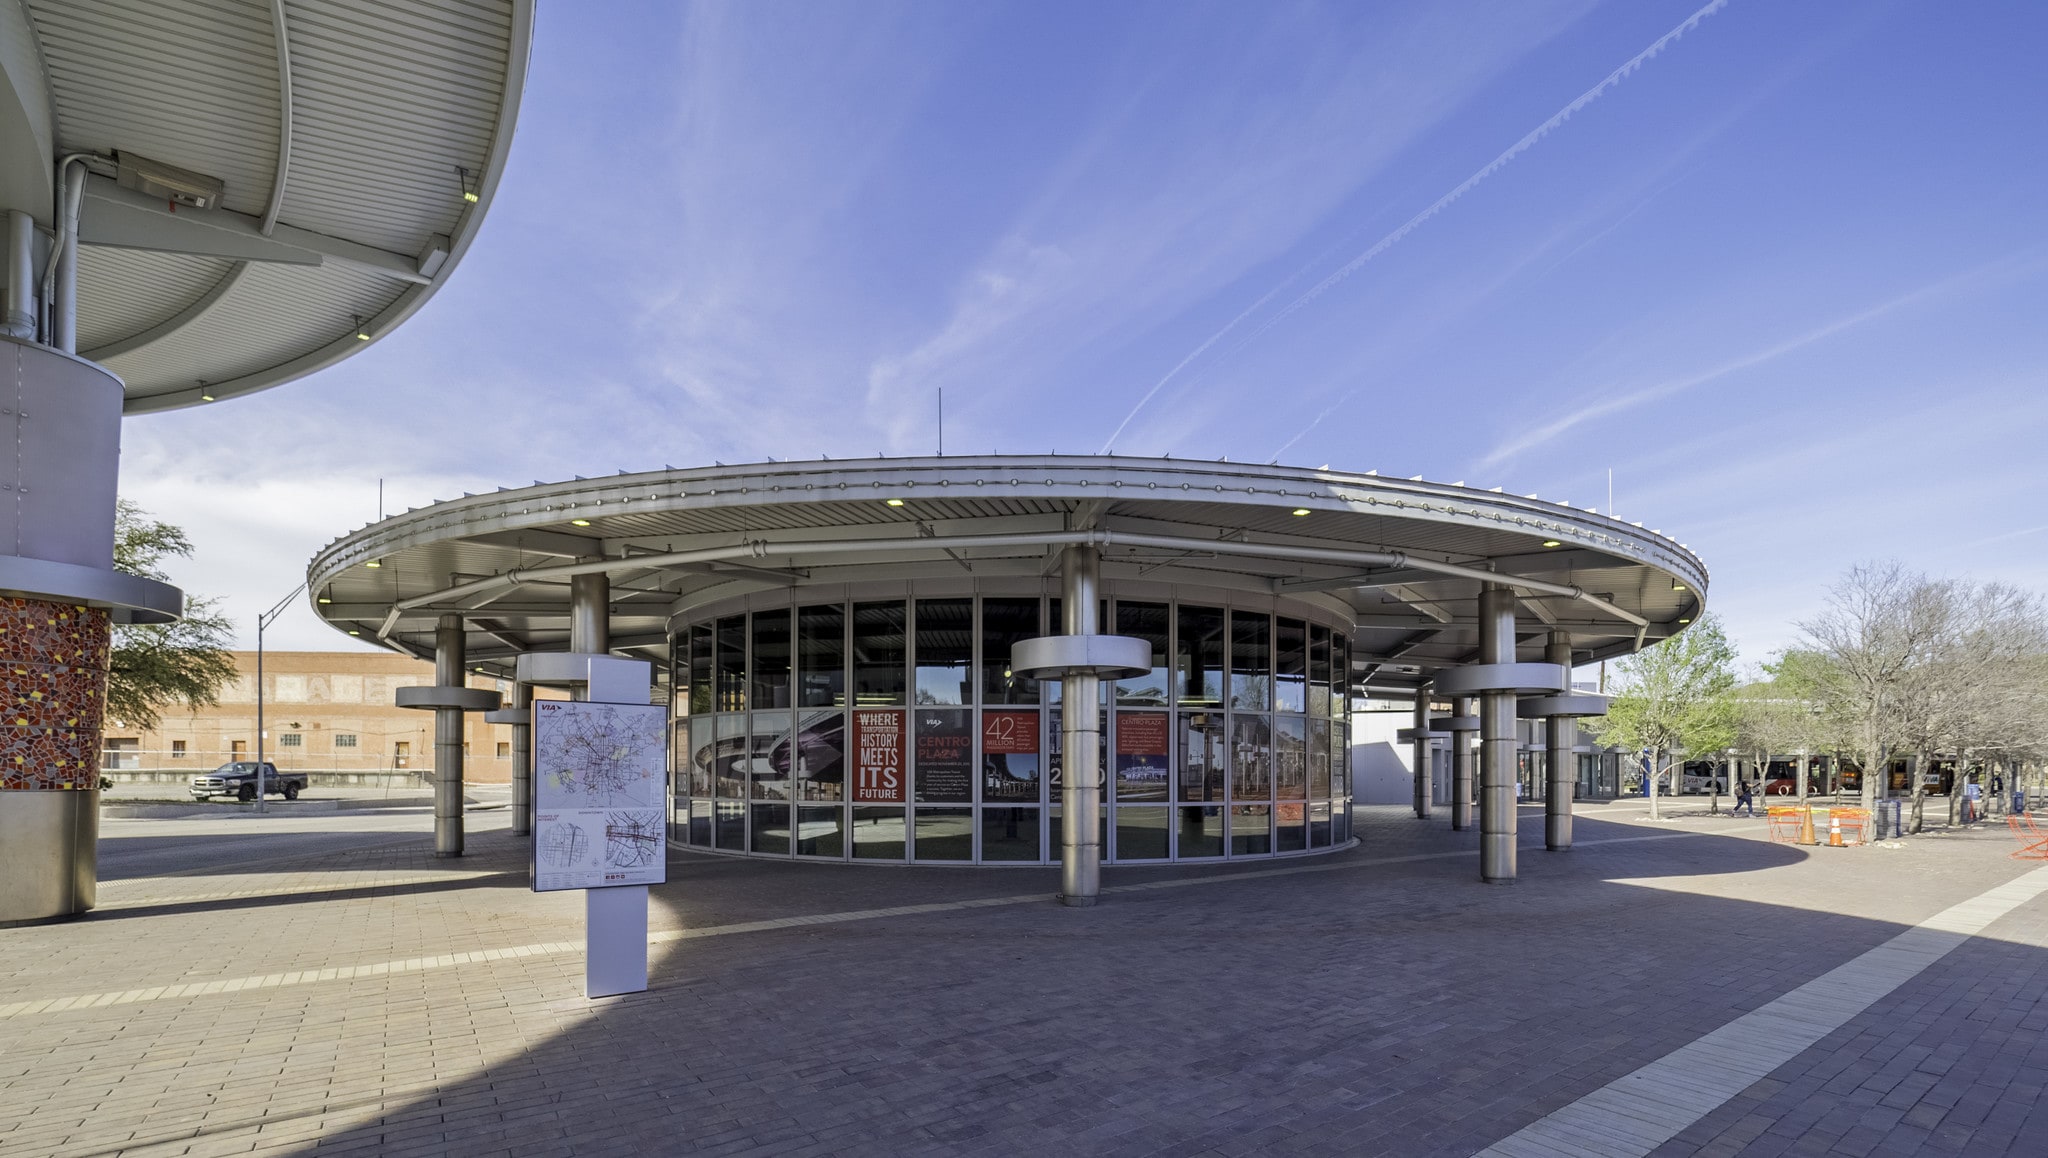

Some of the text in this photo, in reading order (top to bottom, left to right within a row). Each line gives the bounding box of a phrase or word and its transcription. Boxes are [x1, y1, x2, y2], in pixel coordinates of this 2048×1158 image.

[860, 713, 898, 725] WHERE
[985, 716, 1014, 740] 42
[861, 733, 898, 747] HISTORY
[918, 736, 971, 747] CENTRO
[860, 747, 898, 765] MEETS
[918, 749, 960, 758] PLAZA
[860, 767, 898, 788] ITS
[860, 789, 898, 799] FUTURE
